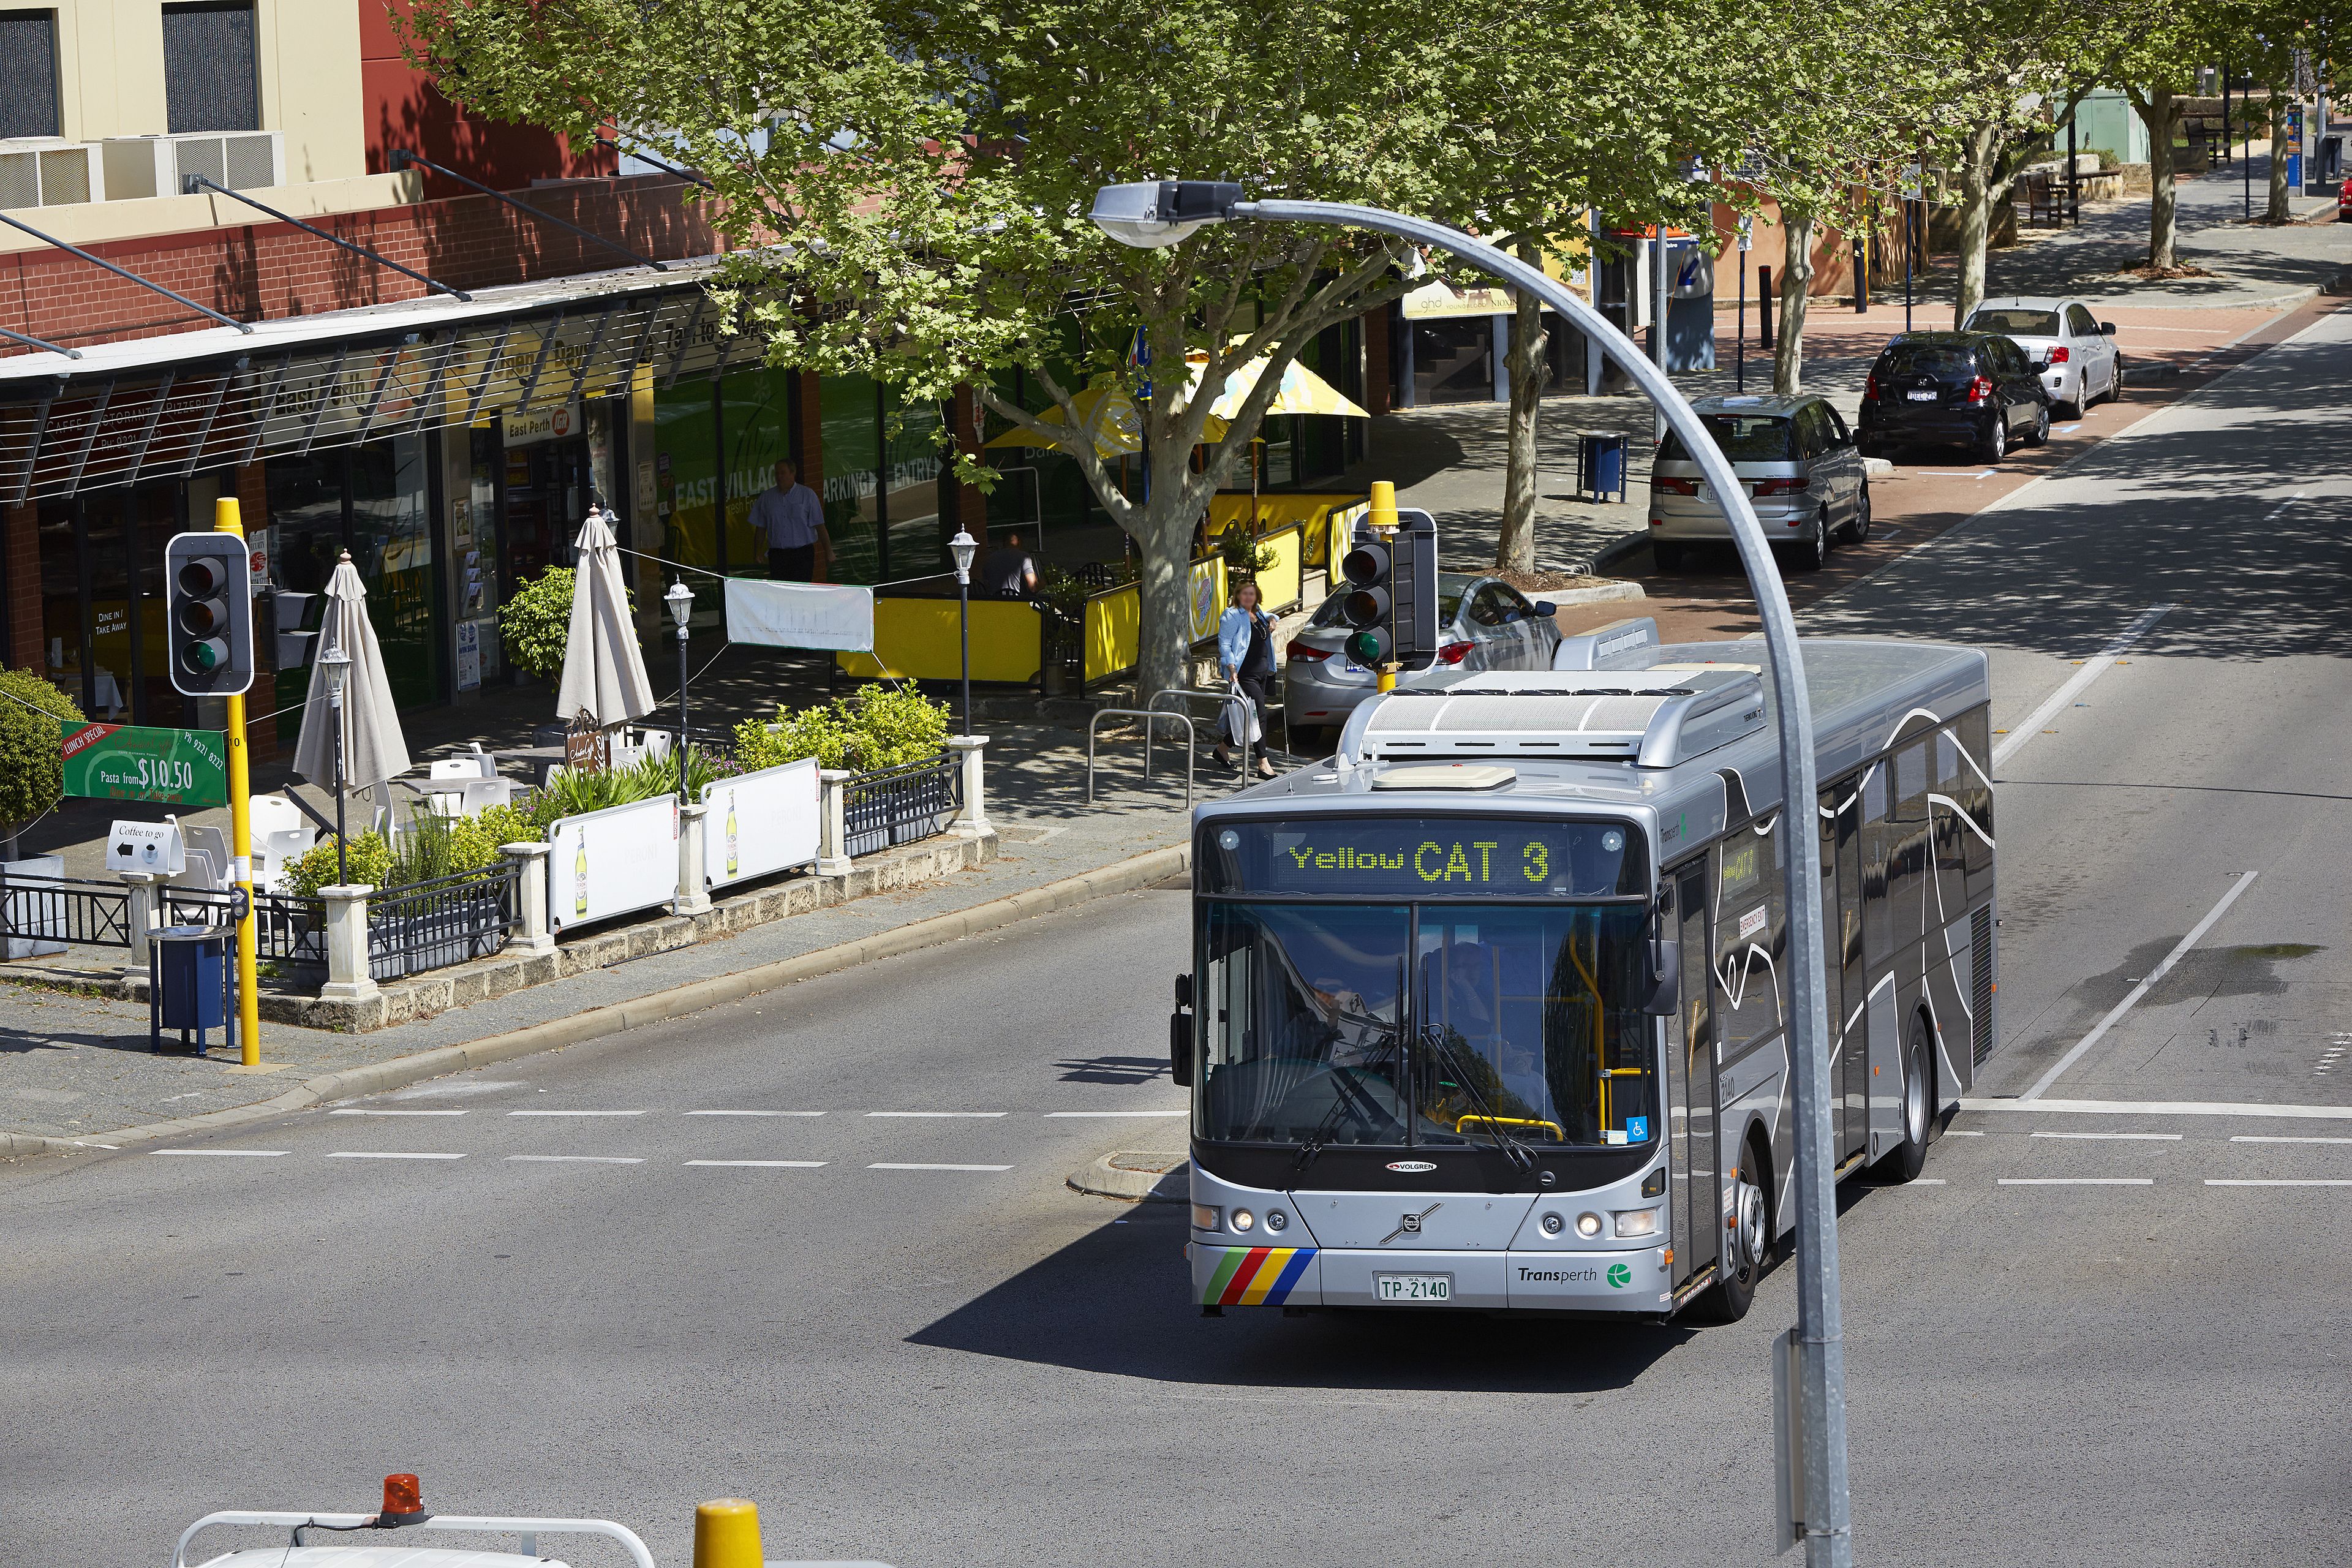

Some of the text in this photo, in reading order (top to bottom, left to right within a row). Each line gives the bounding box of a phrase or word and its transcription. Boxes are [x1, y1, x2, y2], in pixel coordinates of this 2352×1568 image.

[1421, 297, 1441, 313] ghd
[510, 418, 550, 438] East Perth
[555, 413, 568, 430] IGA
[725, 464, 777, 500] VILLAG
[894, 456, 932, 488] ENTRY
[674, 477, 717, 511] EAST
[823, 470, 869, 503] ARKING
[726, 502, 744, 516] resh
[99, 612, 113, 622] DINE
[114, 611, 119, 619] IN
[96, 622, 127, 635] TAKE AWAY
[64, 736, 85, 755] LUNCH
[84, 725, 106, 744] SPECIAL
[184, 731, 224, 771] Ph 9221 8222
[100, 758, 192, 790] Pasta from $10.50
[119, 825, 143, 837] Coffee
[154, 831, 164, 840] go
[624, 843, 657, 865] PERONI
[1289, 841, 1548, 881] Yellow CAT 3
[1740, 913, 1757, 932] EMERGENCY
[1721, 1076, 1735, 1104] 2140
[1518, 1267, 1597, 1285] Transperth
